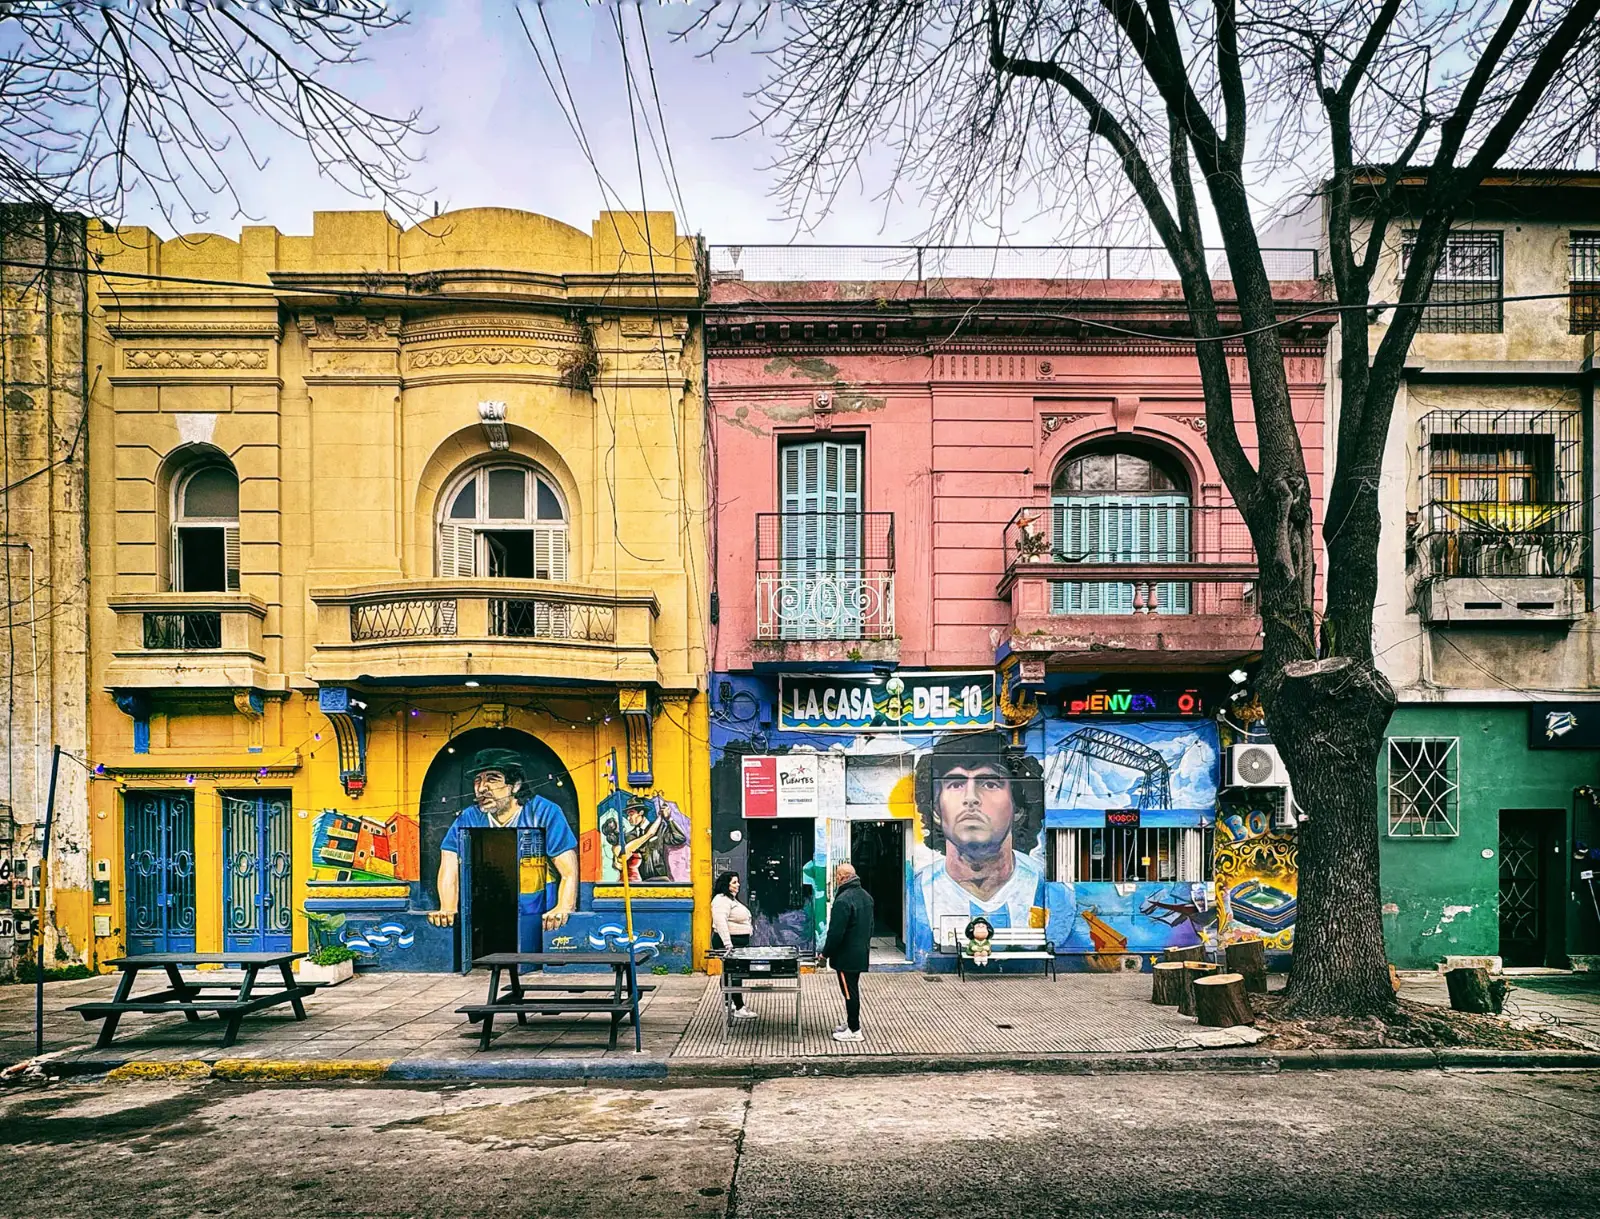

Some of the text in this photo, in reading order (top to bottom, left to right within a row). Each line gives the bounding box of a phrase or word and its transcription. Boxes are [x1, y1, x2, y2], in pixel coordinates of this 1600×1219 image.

[793, 684, 983, 720] LA CASA DEL 10
[1108, 814, 1139, 823] KIOSCO
